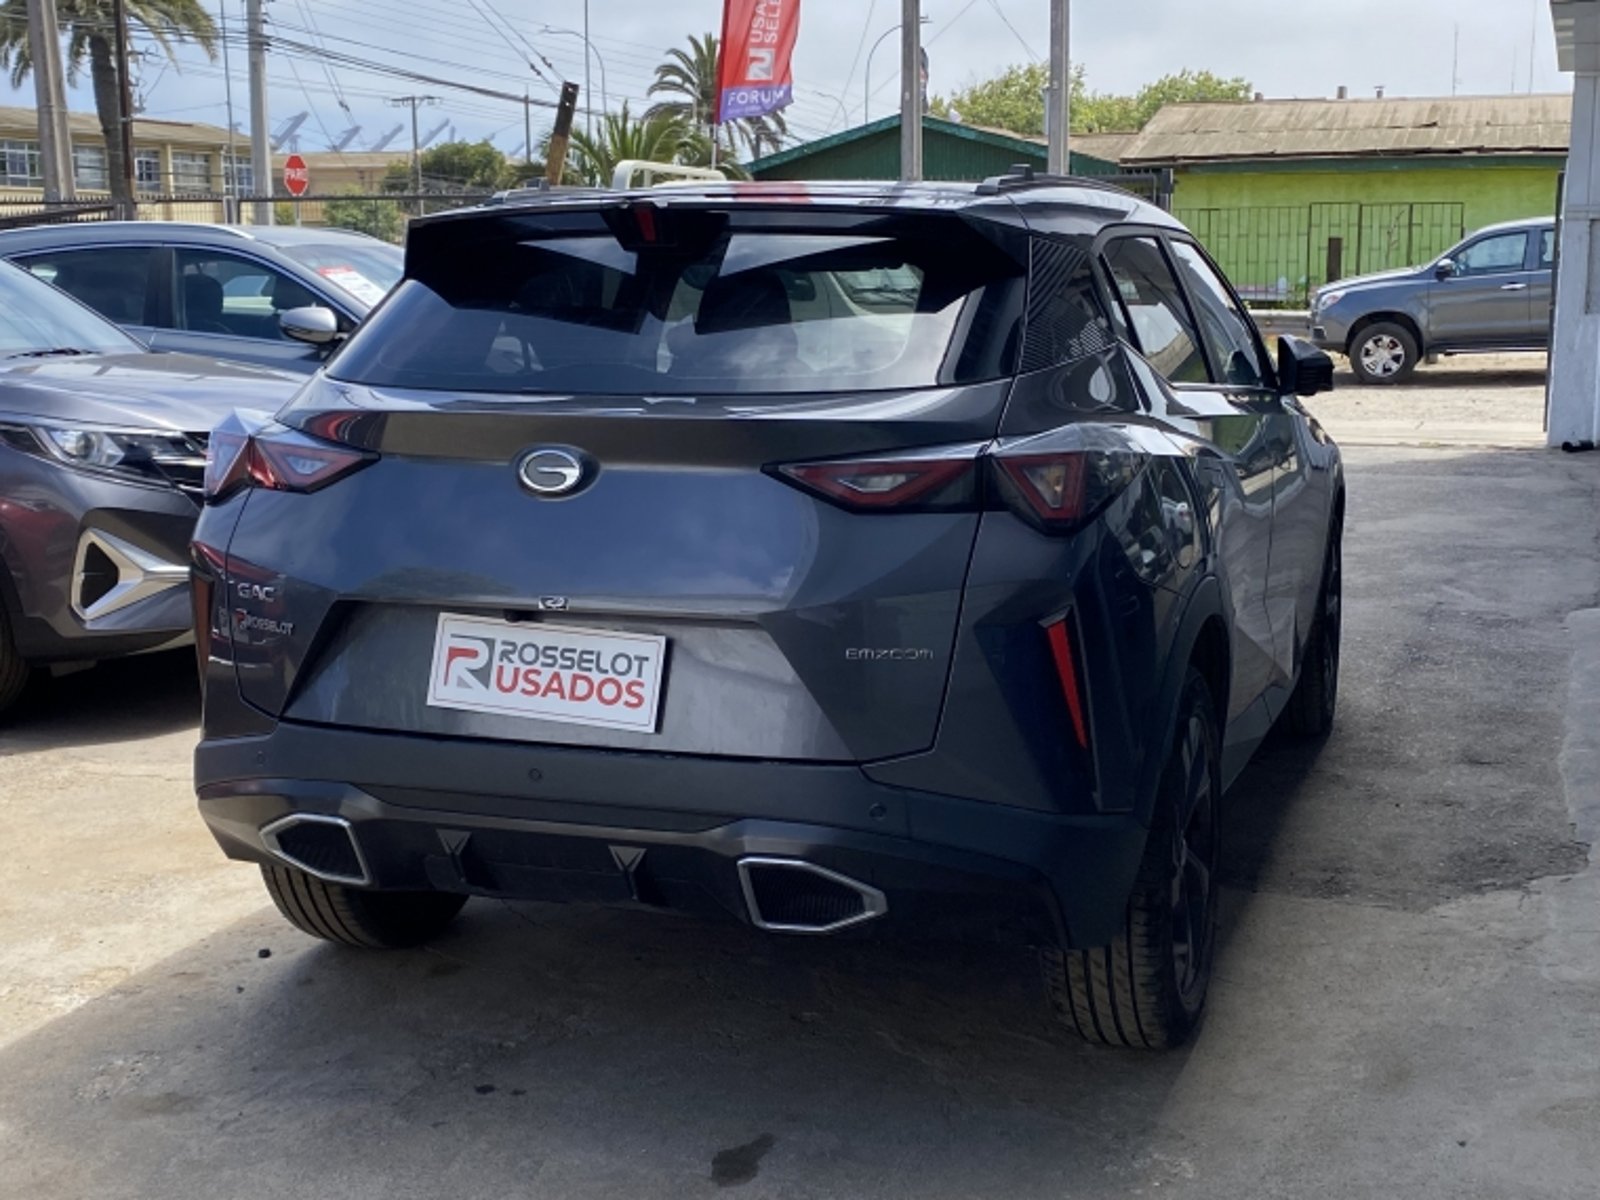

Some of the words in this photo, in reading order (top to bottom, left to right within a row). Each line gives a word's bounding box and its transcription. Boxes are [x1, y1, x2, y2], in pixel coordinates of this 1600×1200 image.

[727, 89, 785, 106] FORUM
[237, 582, 275, 602] GAC
[500, 640, 649, 678] ROSSELOT
[496, 665, 645, 709] USADOS
